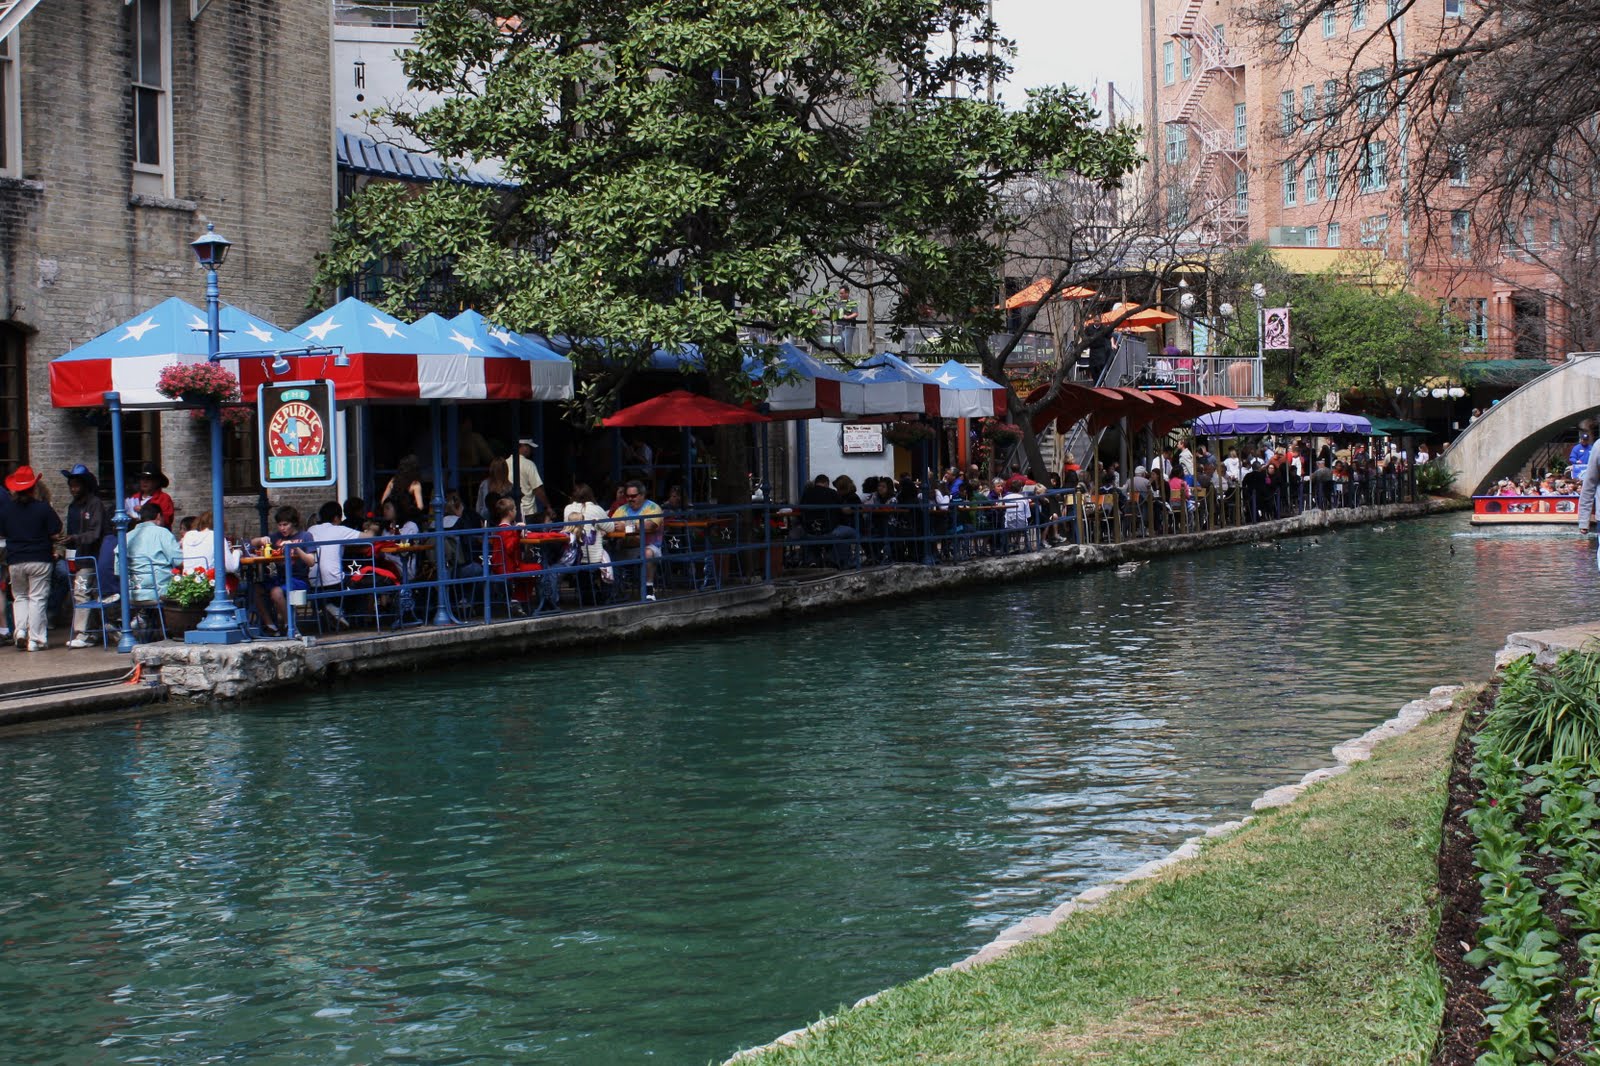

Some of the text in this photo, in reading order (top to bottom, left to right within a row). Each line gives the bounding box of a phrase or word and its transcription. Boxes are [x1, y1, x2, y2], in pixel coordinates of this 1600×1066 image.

[284, 391, 306, 400] THE
[271, 404, 321, 433] REPUBLIC
[275, 457, 320, 477] OF TEXAS
